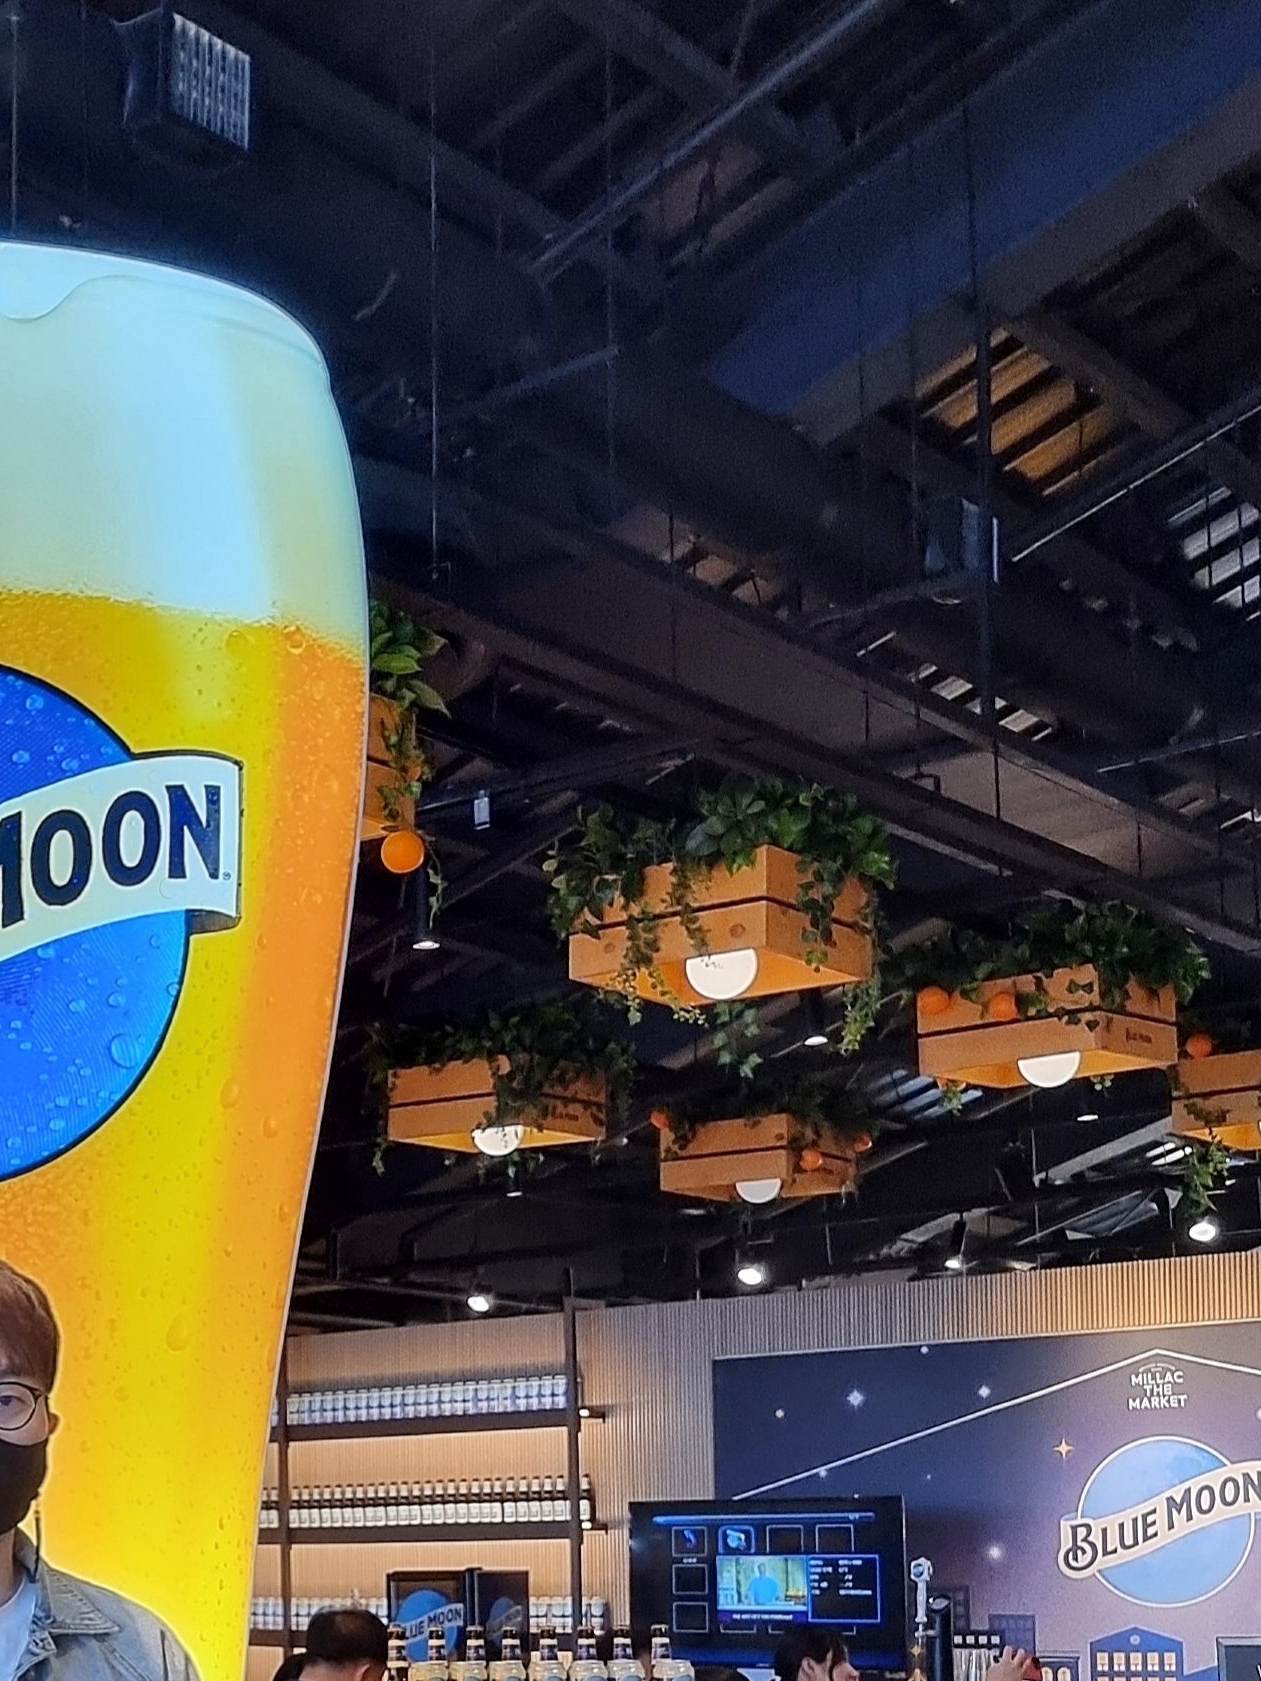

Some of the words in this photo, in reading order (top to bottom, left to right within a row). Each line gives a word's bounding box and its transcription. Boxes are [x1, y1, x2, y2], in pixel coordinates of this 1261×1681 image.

[1131, 1370, 1184, 1387] MILLAC
[1143, 1383, 1173, 1397] THE
[1128, 1394, 1188, 1411] MARKET
[1063, 1507, 1159, 1571] BLUE
[1166, 1470, 1261, 1532] MOON
[427, 1607, 462, 1629] MOON
